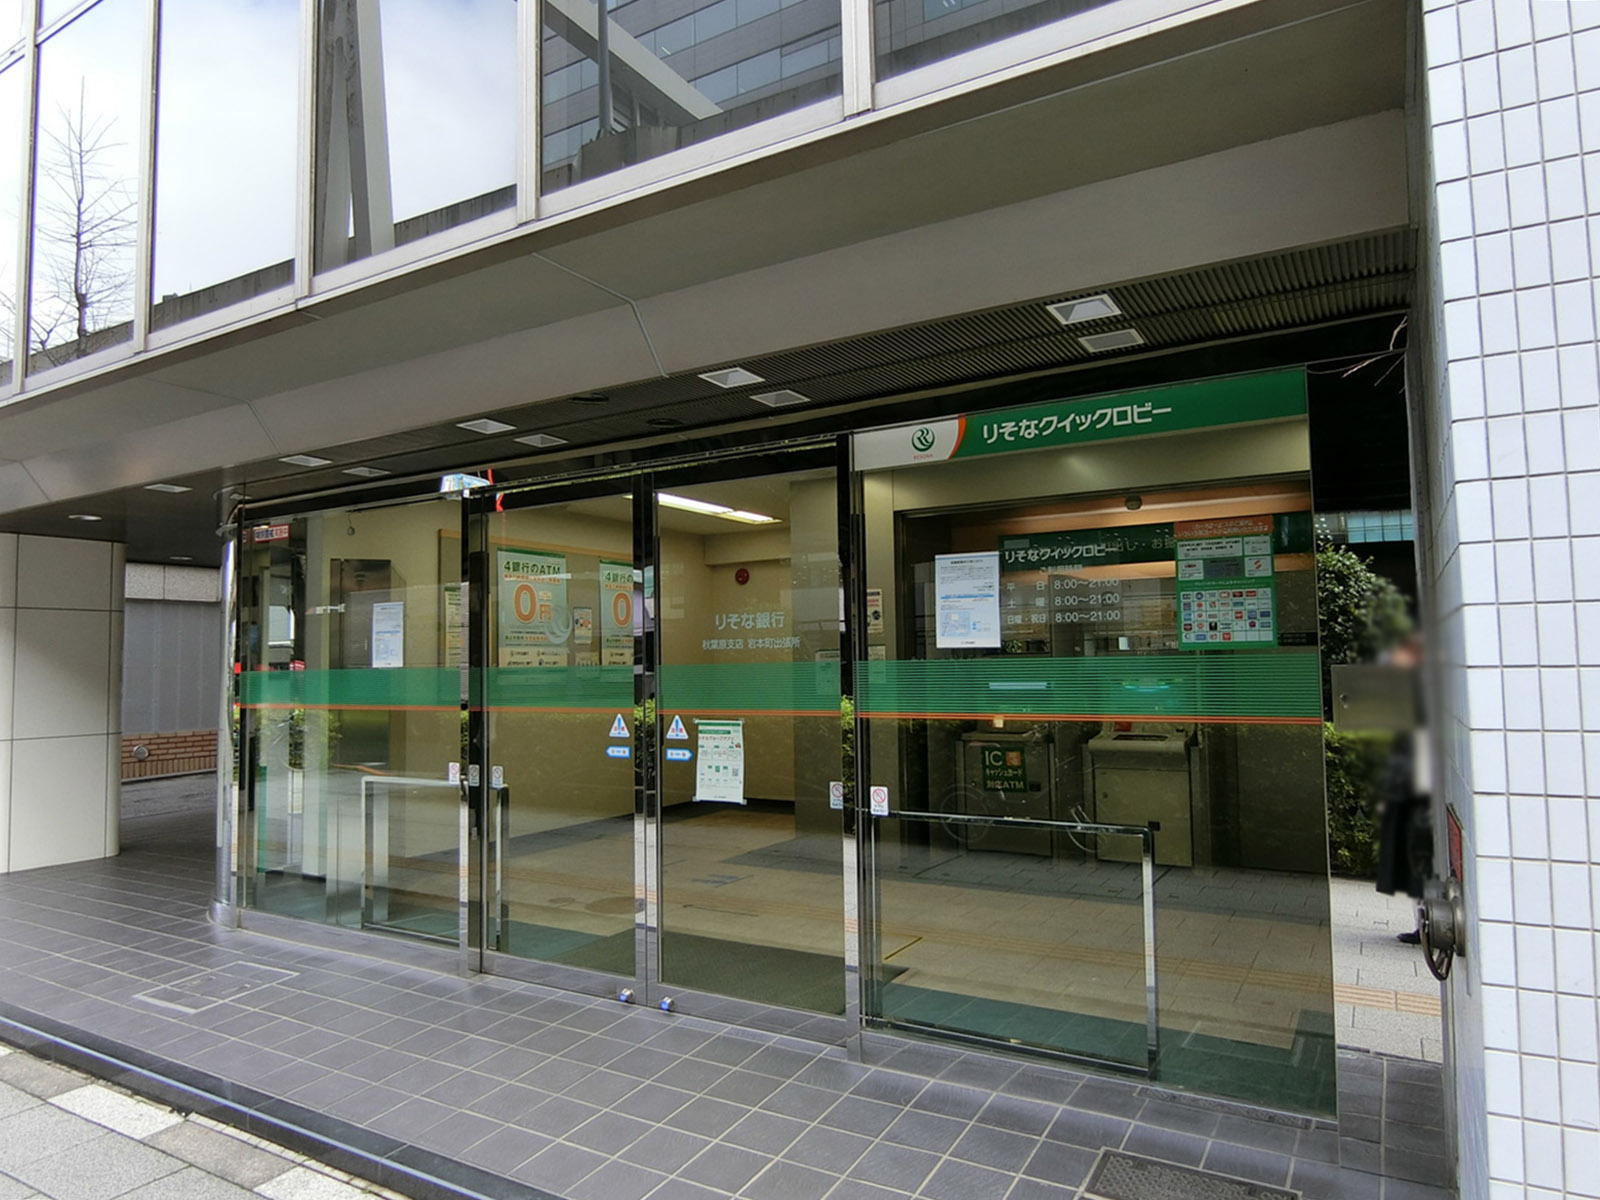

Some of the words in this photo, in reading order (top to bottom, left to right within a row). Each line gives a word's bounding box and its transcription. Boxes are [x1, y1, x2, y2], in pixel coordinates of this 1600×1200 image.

[982, 402, 1172, 444] りそなクイックロビー
[1005, 544, 1119, 564] りそなクイックロビー
[504, 560, 561, 575] 4銀行のATM
[715, 612, 784, 630] りそな銀行
[984, 750, 1003, 766] IC
